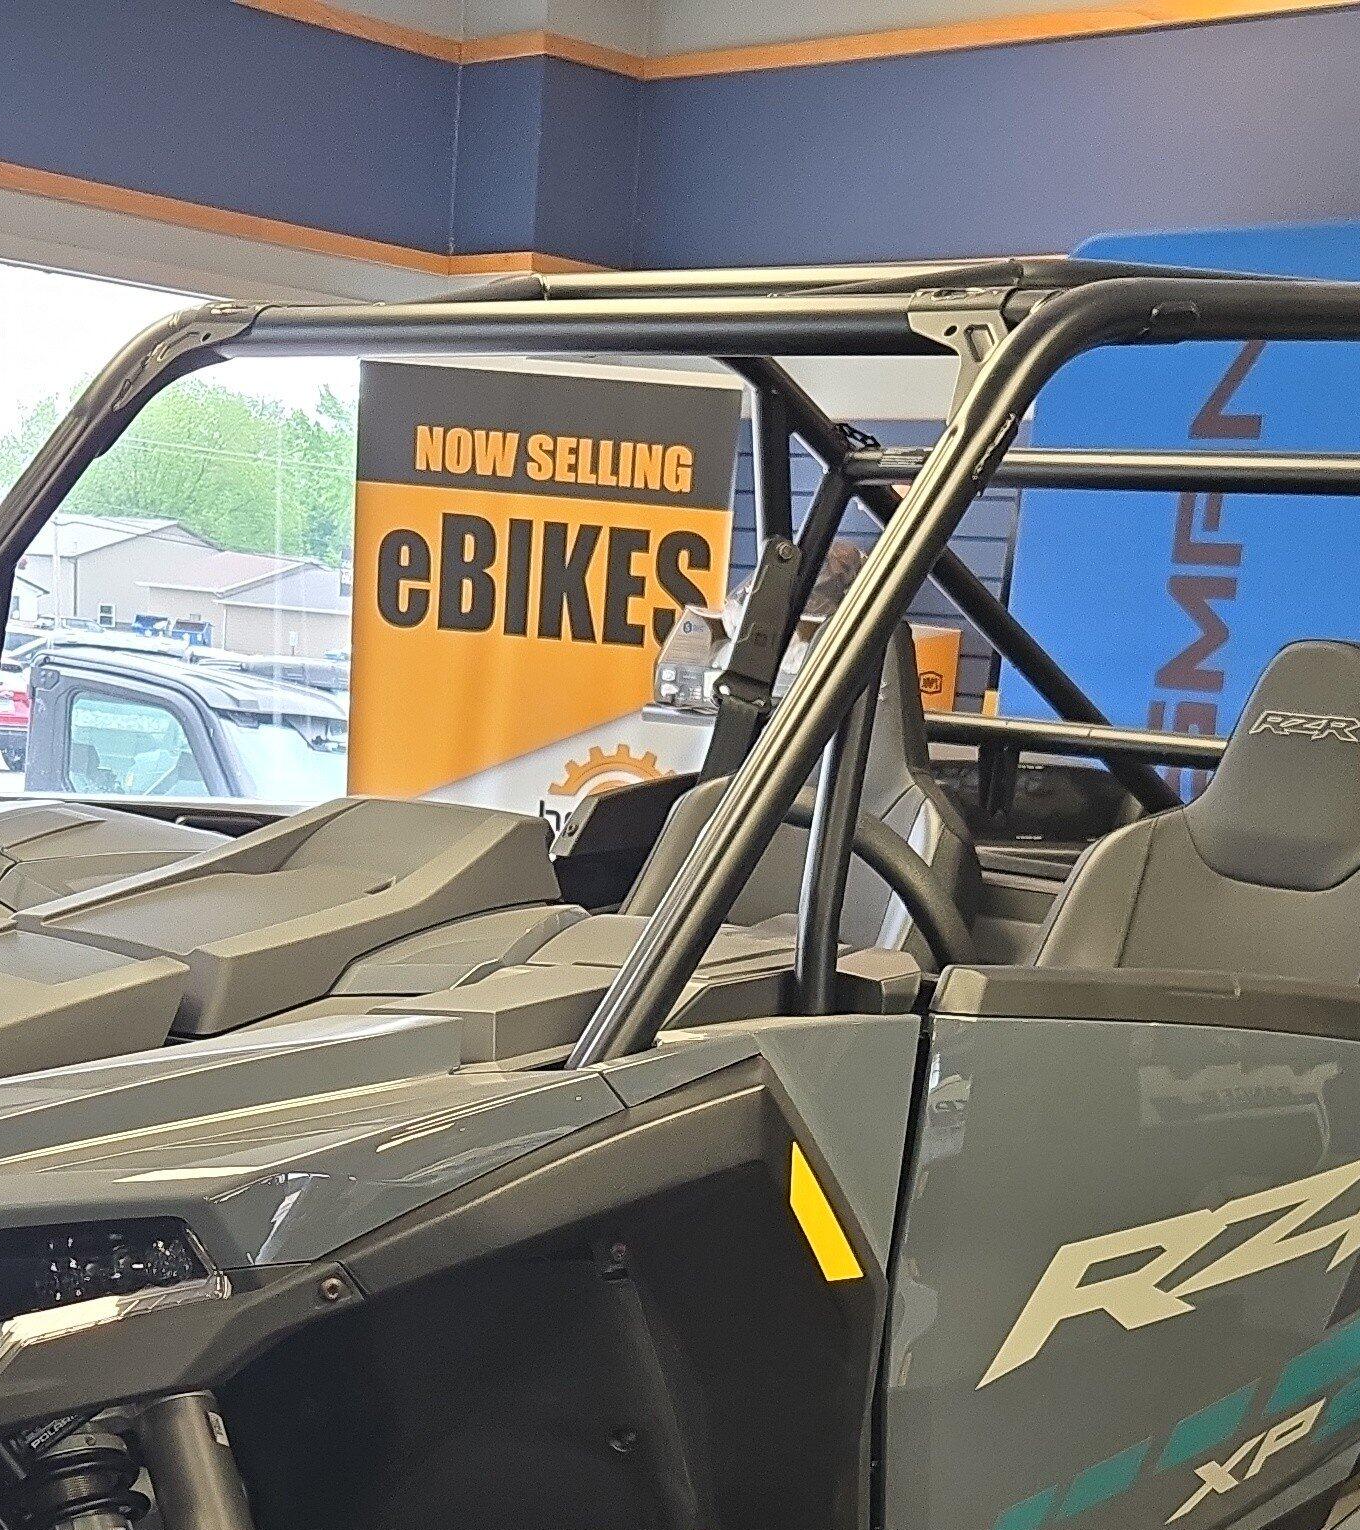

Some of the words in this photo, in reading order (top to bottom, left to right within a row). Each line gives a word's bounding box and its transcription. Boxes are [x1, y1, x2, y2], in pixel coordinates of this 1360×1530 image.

[414, 425, 518, 479] NOW
[526, 433, 694, 493] SELLING
[377, 511, 711, 648] eBIKES
[31, 1413, 78, 1449] POLAR
[1165, 1397, 1326, 1525] XP
